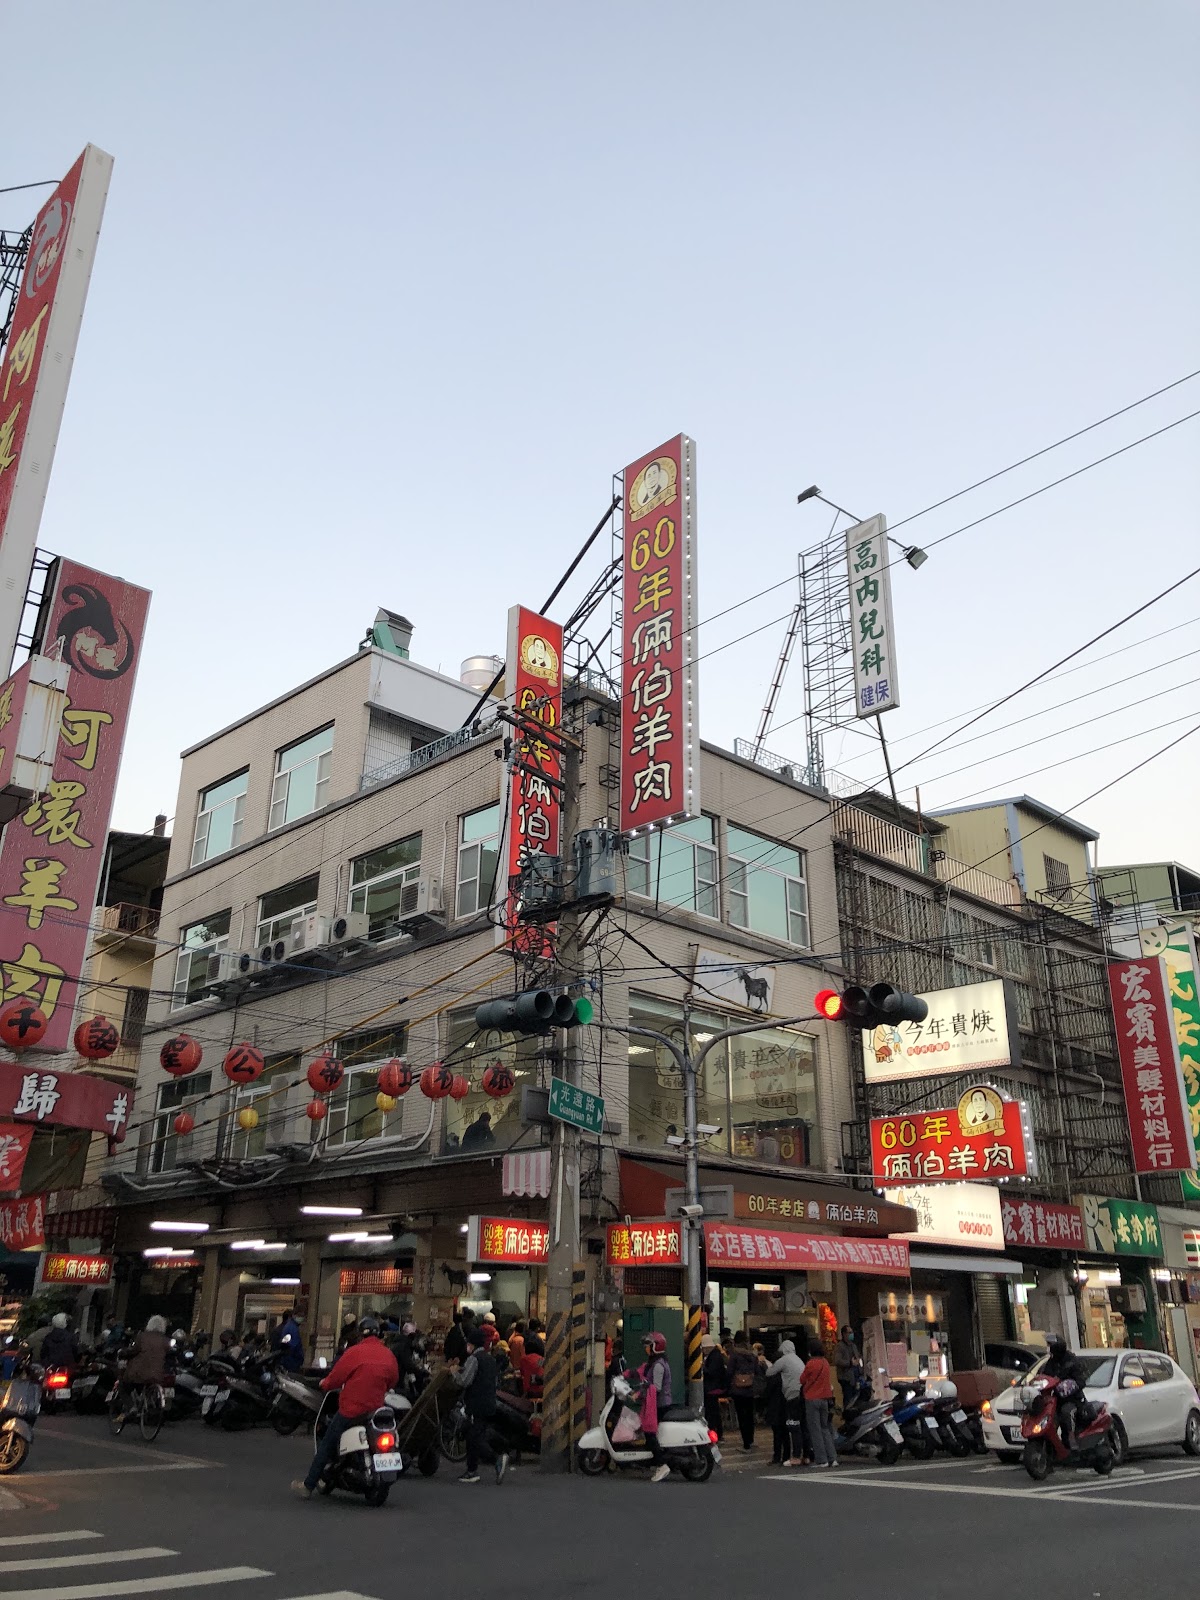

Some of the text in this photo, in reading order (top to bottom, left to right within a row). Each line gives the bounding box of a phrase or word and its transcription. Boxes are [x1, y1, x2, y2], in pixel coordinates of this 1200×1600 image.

[860, 679, 891, 709] 健保
[229, 1048, 263, 1075] 公
[1120, 964, 1175, 1169] 宏賓美髮材料行
[560, 1085, 595, 1113] 光遠路
[880, 1115, 952, 1150] 60年
[881, 1142, 1014, 1180] 倆伯羊肉
[748, 1194, 805, 1218] 60年老店
[825, 1202, 879, 1225] 倆伯羊肉
[630, 1229, 679, 1257] 倆伯羊肉
[65, 1259, 110, 1279] 倆伯羊肉
